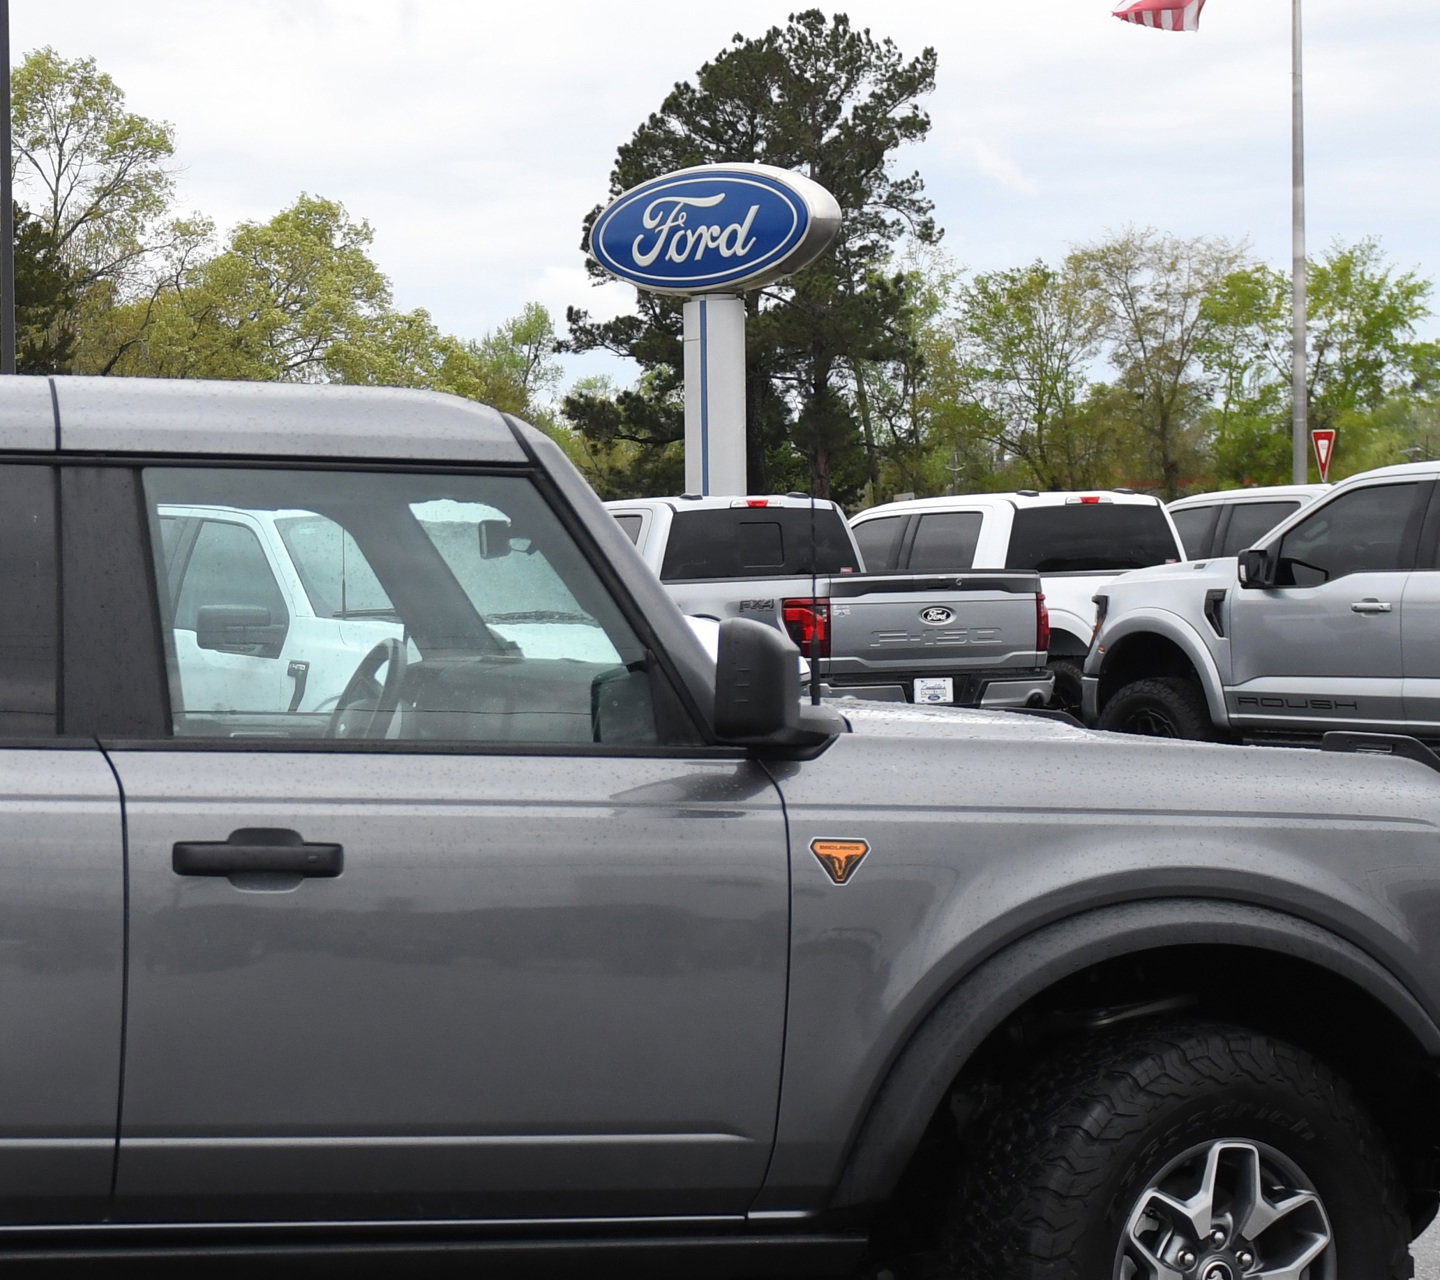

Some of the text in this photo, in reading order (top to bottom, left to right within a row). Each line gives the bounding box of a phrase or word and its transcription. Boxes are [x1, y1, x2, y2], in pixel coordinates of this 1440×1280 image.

[632, 193, 760, 267] Ford
[739, 599, 775, 613] FX4
[926, 609, 949, 622] Ford
[1237, 697, 1358, 711] ROUSH
